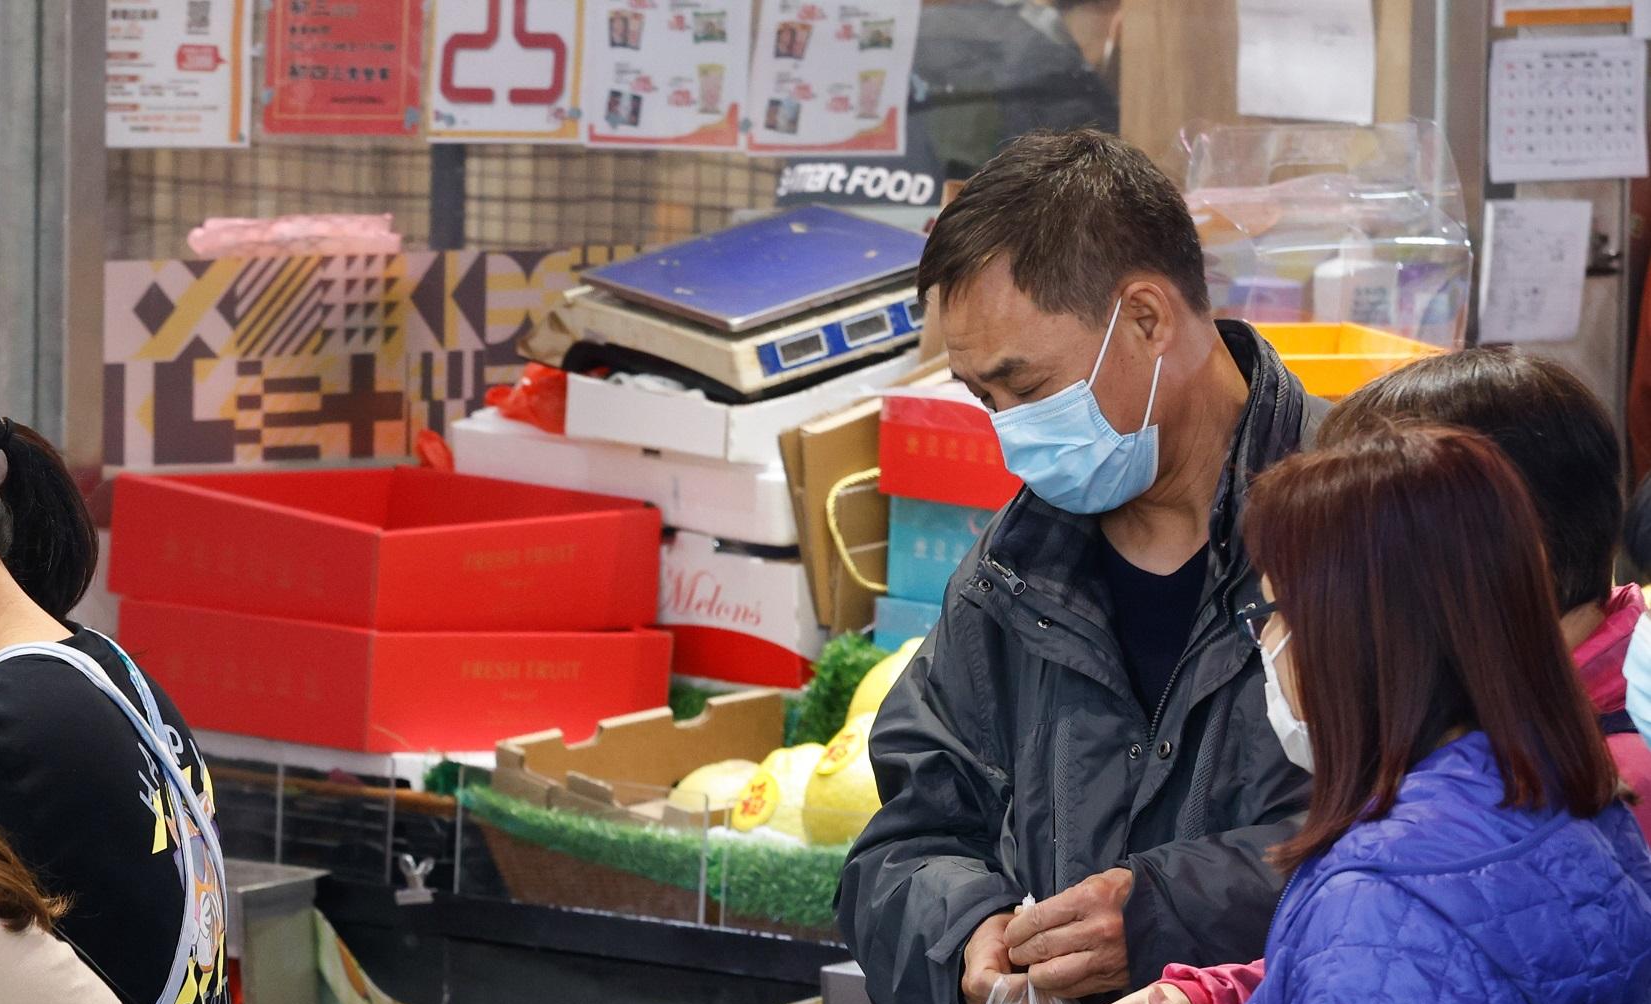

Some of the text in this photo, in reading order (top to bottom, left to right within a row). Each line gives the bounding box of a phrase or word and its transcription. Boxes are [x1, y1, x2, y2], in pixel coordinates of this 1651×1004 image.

[845, 166, 935, 205] FOOD
[460, 660, 582, 680] FRESH FRUIT
